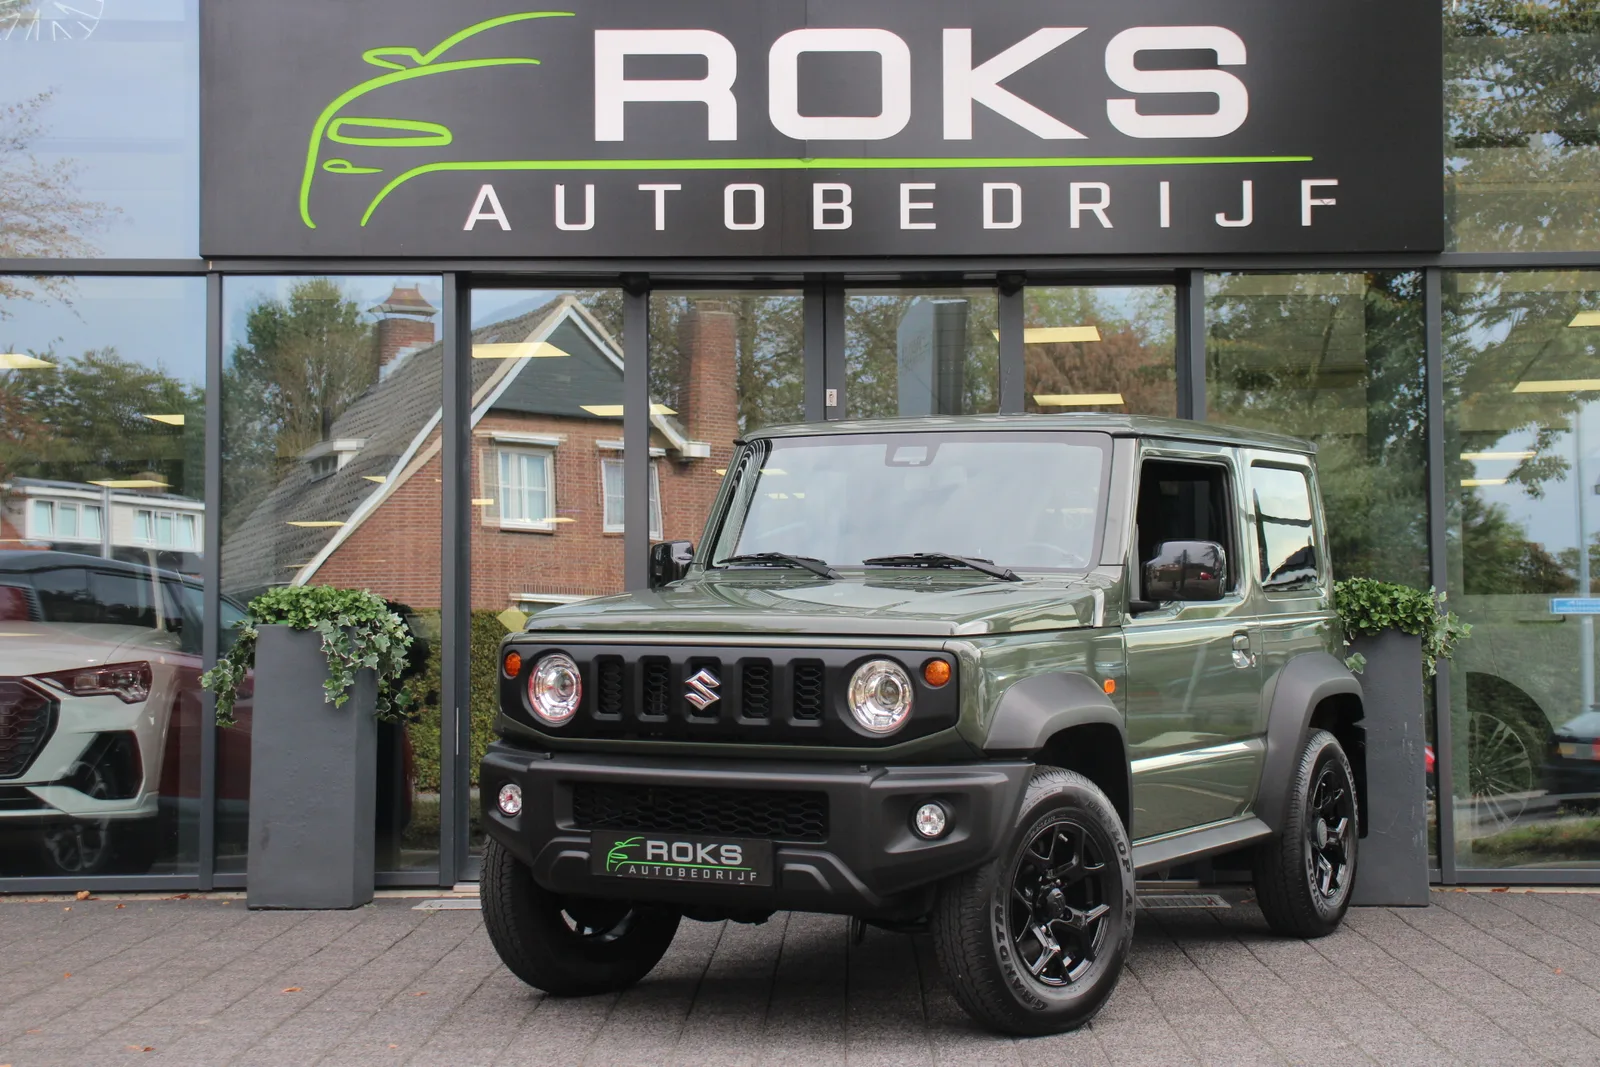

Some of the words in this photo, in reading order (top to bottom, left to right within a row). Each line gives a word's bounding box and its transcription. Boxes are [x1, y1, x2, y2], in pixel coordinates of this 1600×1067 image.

[594, 25, 1249, 142] ROKS
[463, 179, 1338, 231] AUTOBEDRIJF
[646, 840, 743, 865] ROKS
[629, 865, 757, 882] AUTOBEDRIJF
